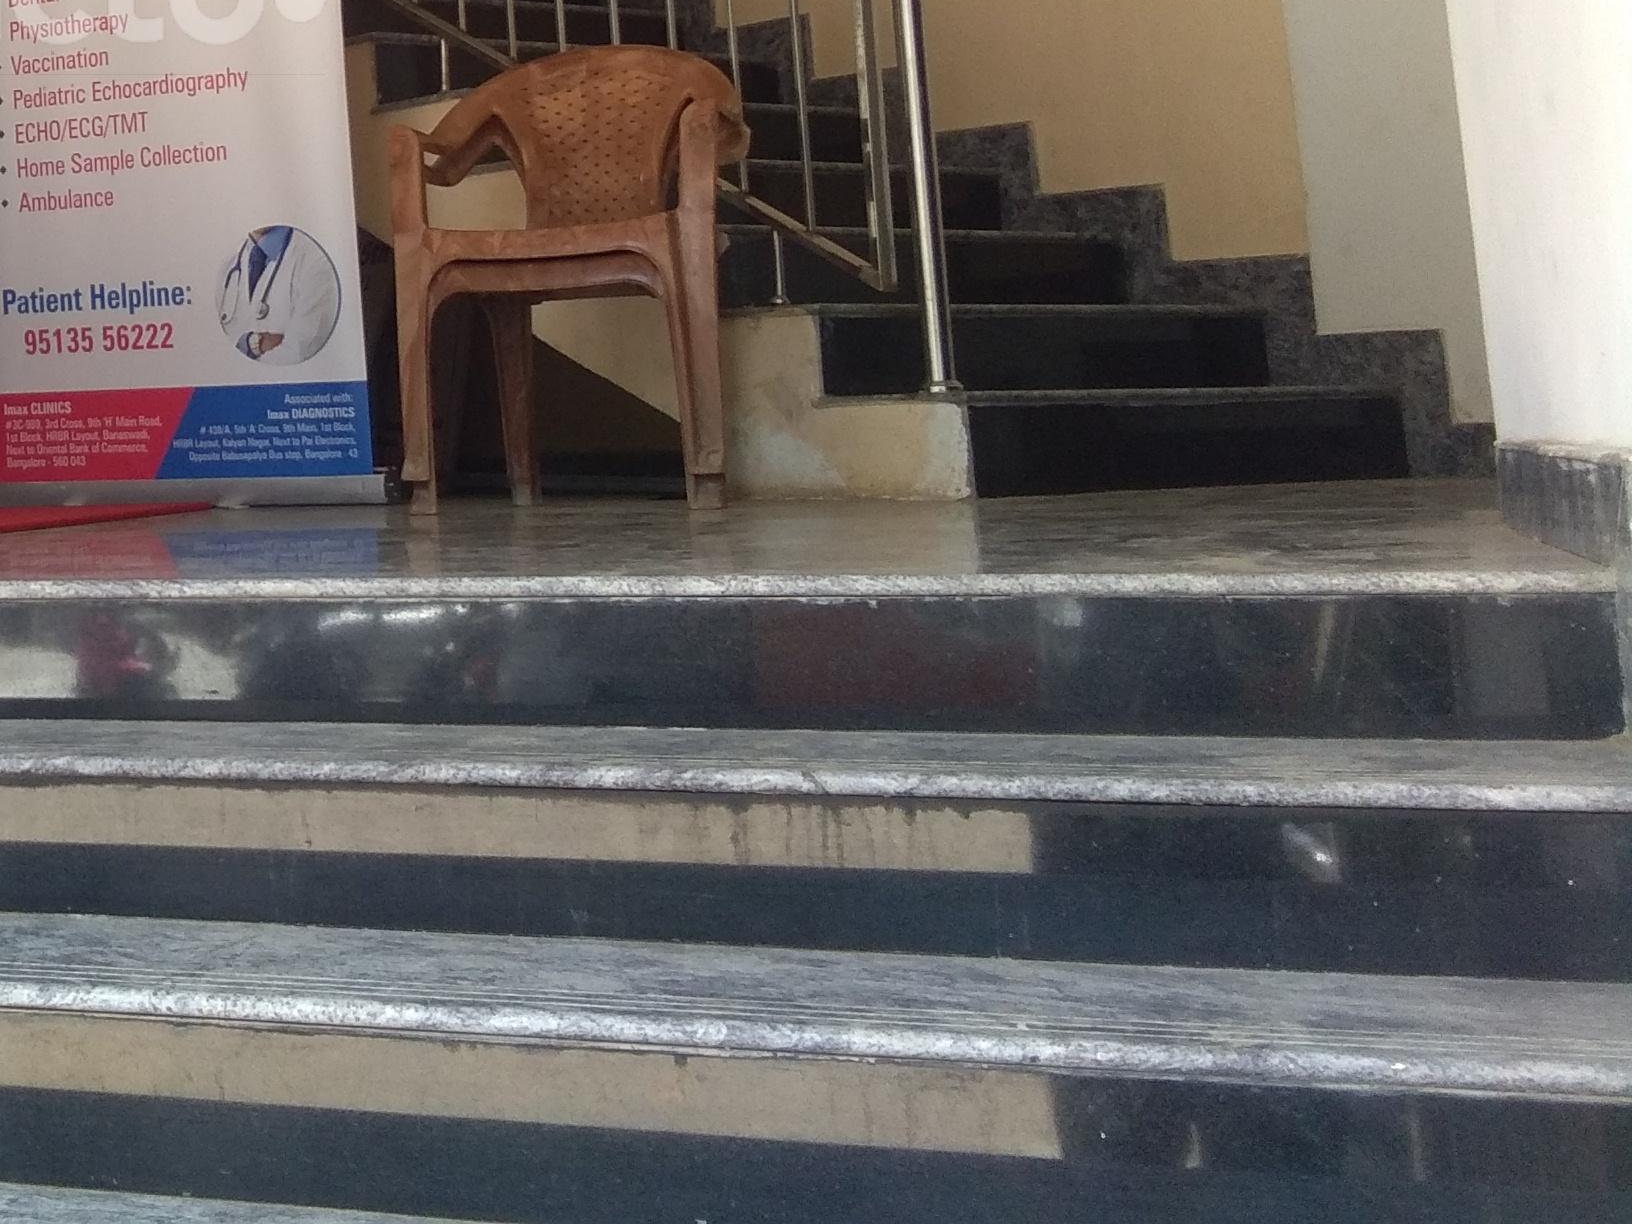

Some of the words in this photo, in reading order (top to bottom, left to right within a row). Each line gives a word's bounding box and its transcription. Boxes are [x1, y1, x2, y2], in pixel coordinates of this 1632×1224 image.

[9, 12, 128, 43] Physiotherapy
[10, 47, 109, 76] Vaccination
[13, 82, 86, 109] Pediatric
[92, 66, 248, 102] Echocardiography
[15, 111, 148, 144] ECHO/ECG/TMT
[17, 155, 65, 178] Home
[71, 148, 134, 175] Sample
[140, 141, 227, 168] Collection
[19, 187, 114, 213] Ambulance
[2, 286, 82, 315] Patient
[90, 280, 192, 314] Helpline:
[24, 327, 93, 355] 95135
[103, 322, 174, 351] 56222
[4, 403, 28, 415] Imax
[31, 401, 72, 415] CLINICS
[267, 409, 290, 420] Imax
[291, 406, 356, 419] DIAGNOSTICS
[284, 393, 330, 404] Associated
